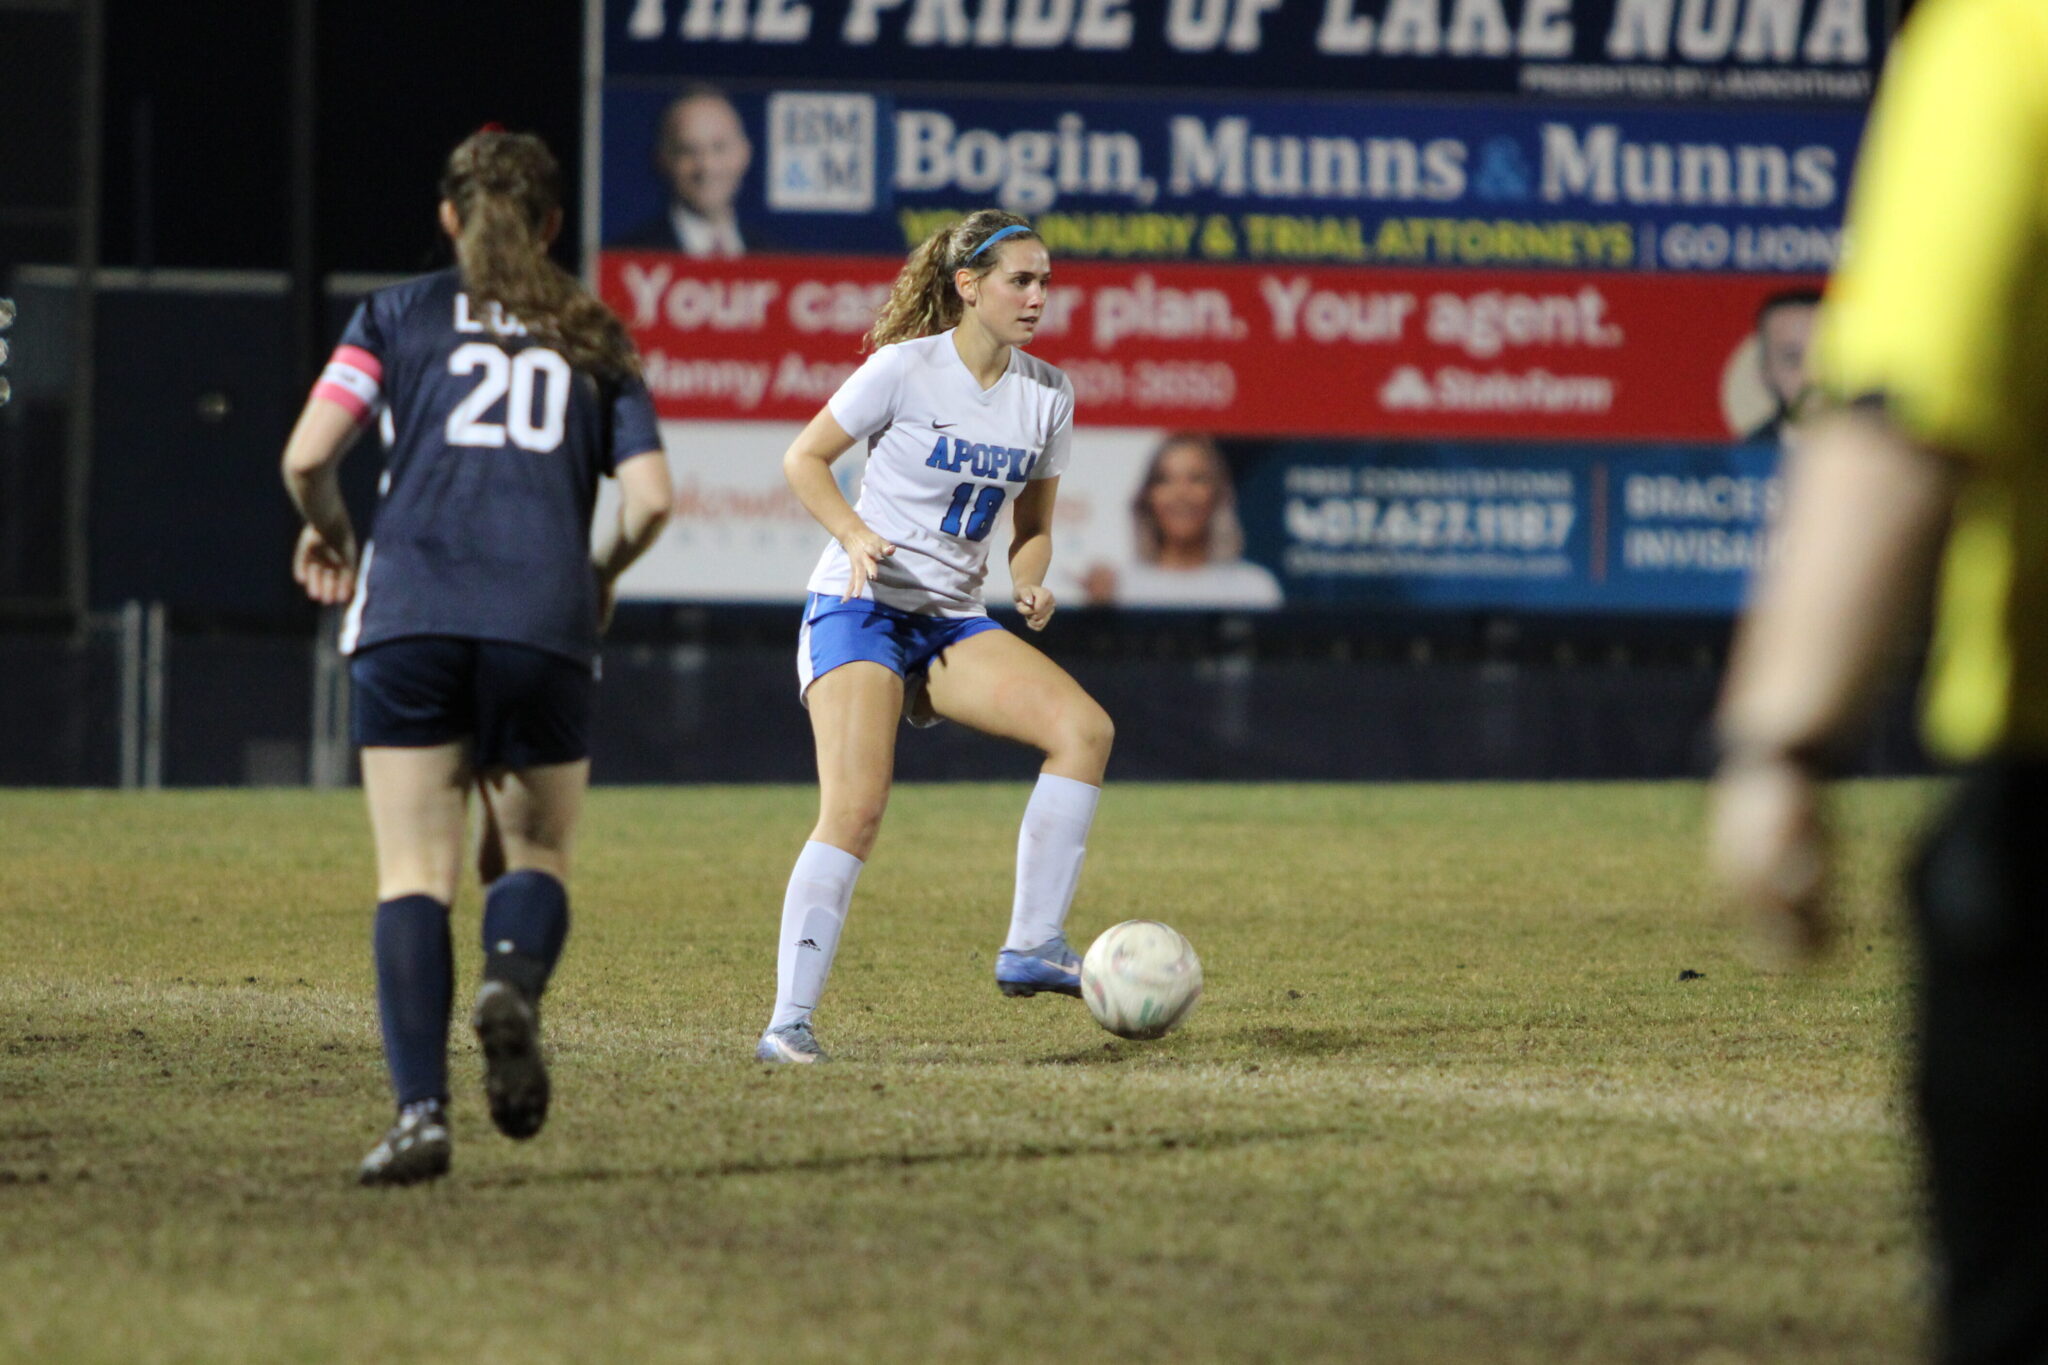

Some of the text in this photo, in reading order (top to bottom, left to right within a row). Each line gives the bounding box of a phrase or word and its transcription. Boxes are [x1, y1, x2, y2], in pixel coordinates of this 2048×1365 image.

[843, 0, 1134, 50] PRIDE
[1166, 0, 1283, 53] OF
[1315, 0, 1574, 55] LAKE
[1606, 0, 1869, 62] NONA
[895, 110, 1838, 214] Bogin, Munns & Munns
[1036, 211, 1197, 256] INJURY
[1202, 213, 1238, 256] &
[1241, 214, 1366, 260] TRIAL
[1372, 216, 1635, 267] ATTORNEYS
[1661, 222, 1731, 271] GO
[621, 262, 780, 332] Your
[1093, 271, 1249, 353] plan.
[1259, 274, 1418, 343] Your
[1425, 285, 1625, 360] agent.
[446, 342, 571, 453] 20
[939, 481, 1006, 543] 18
